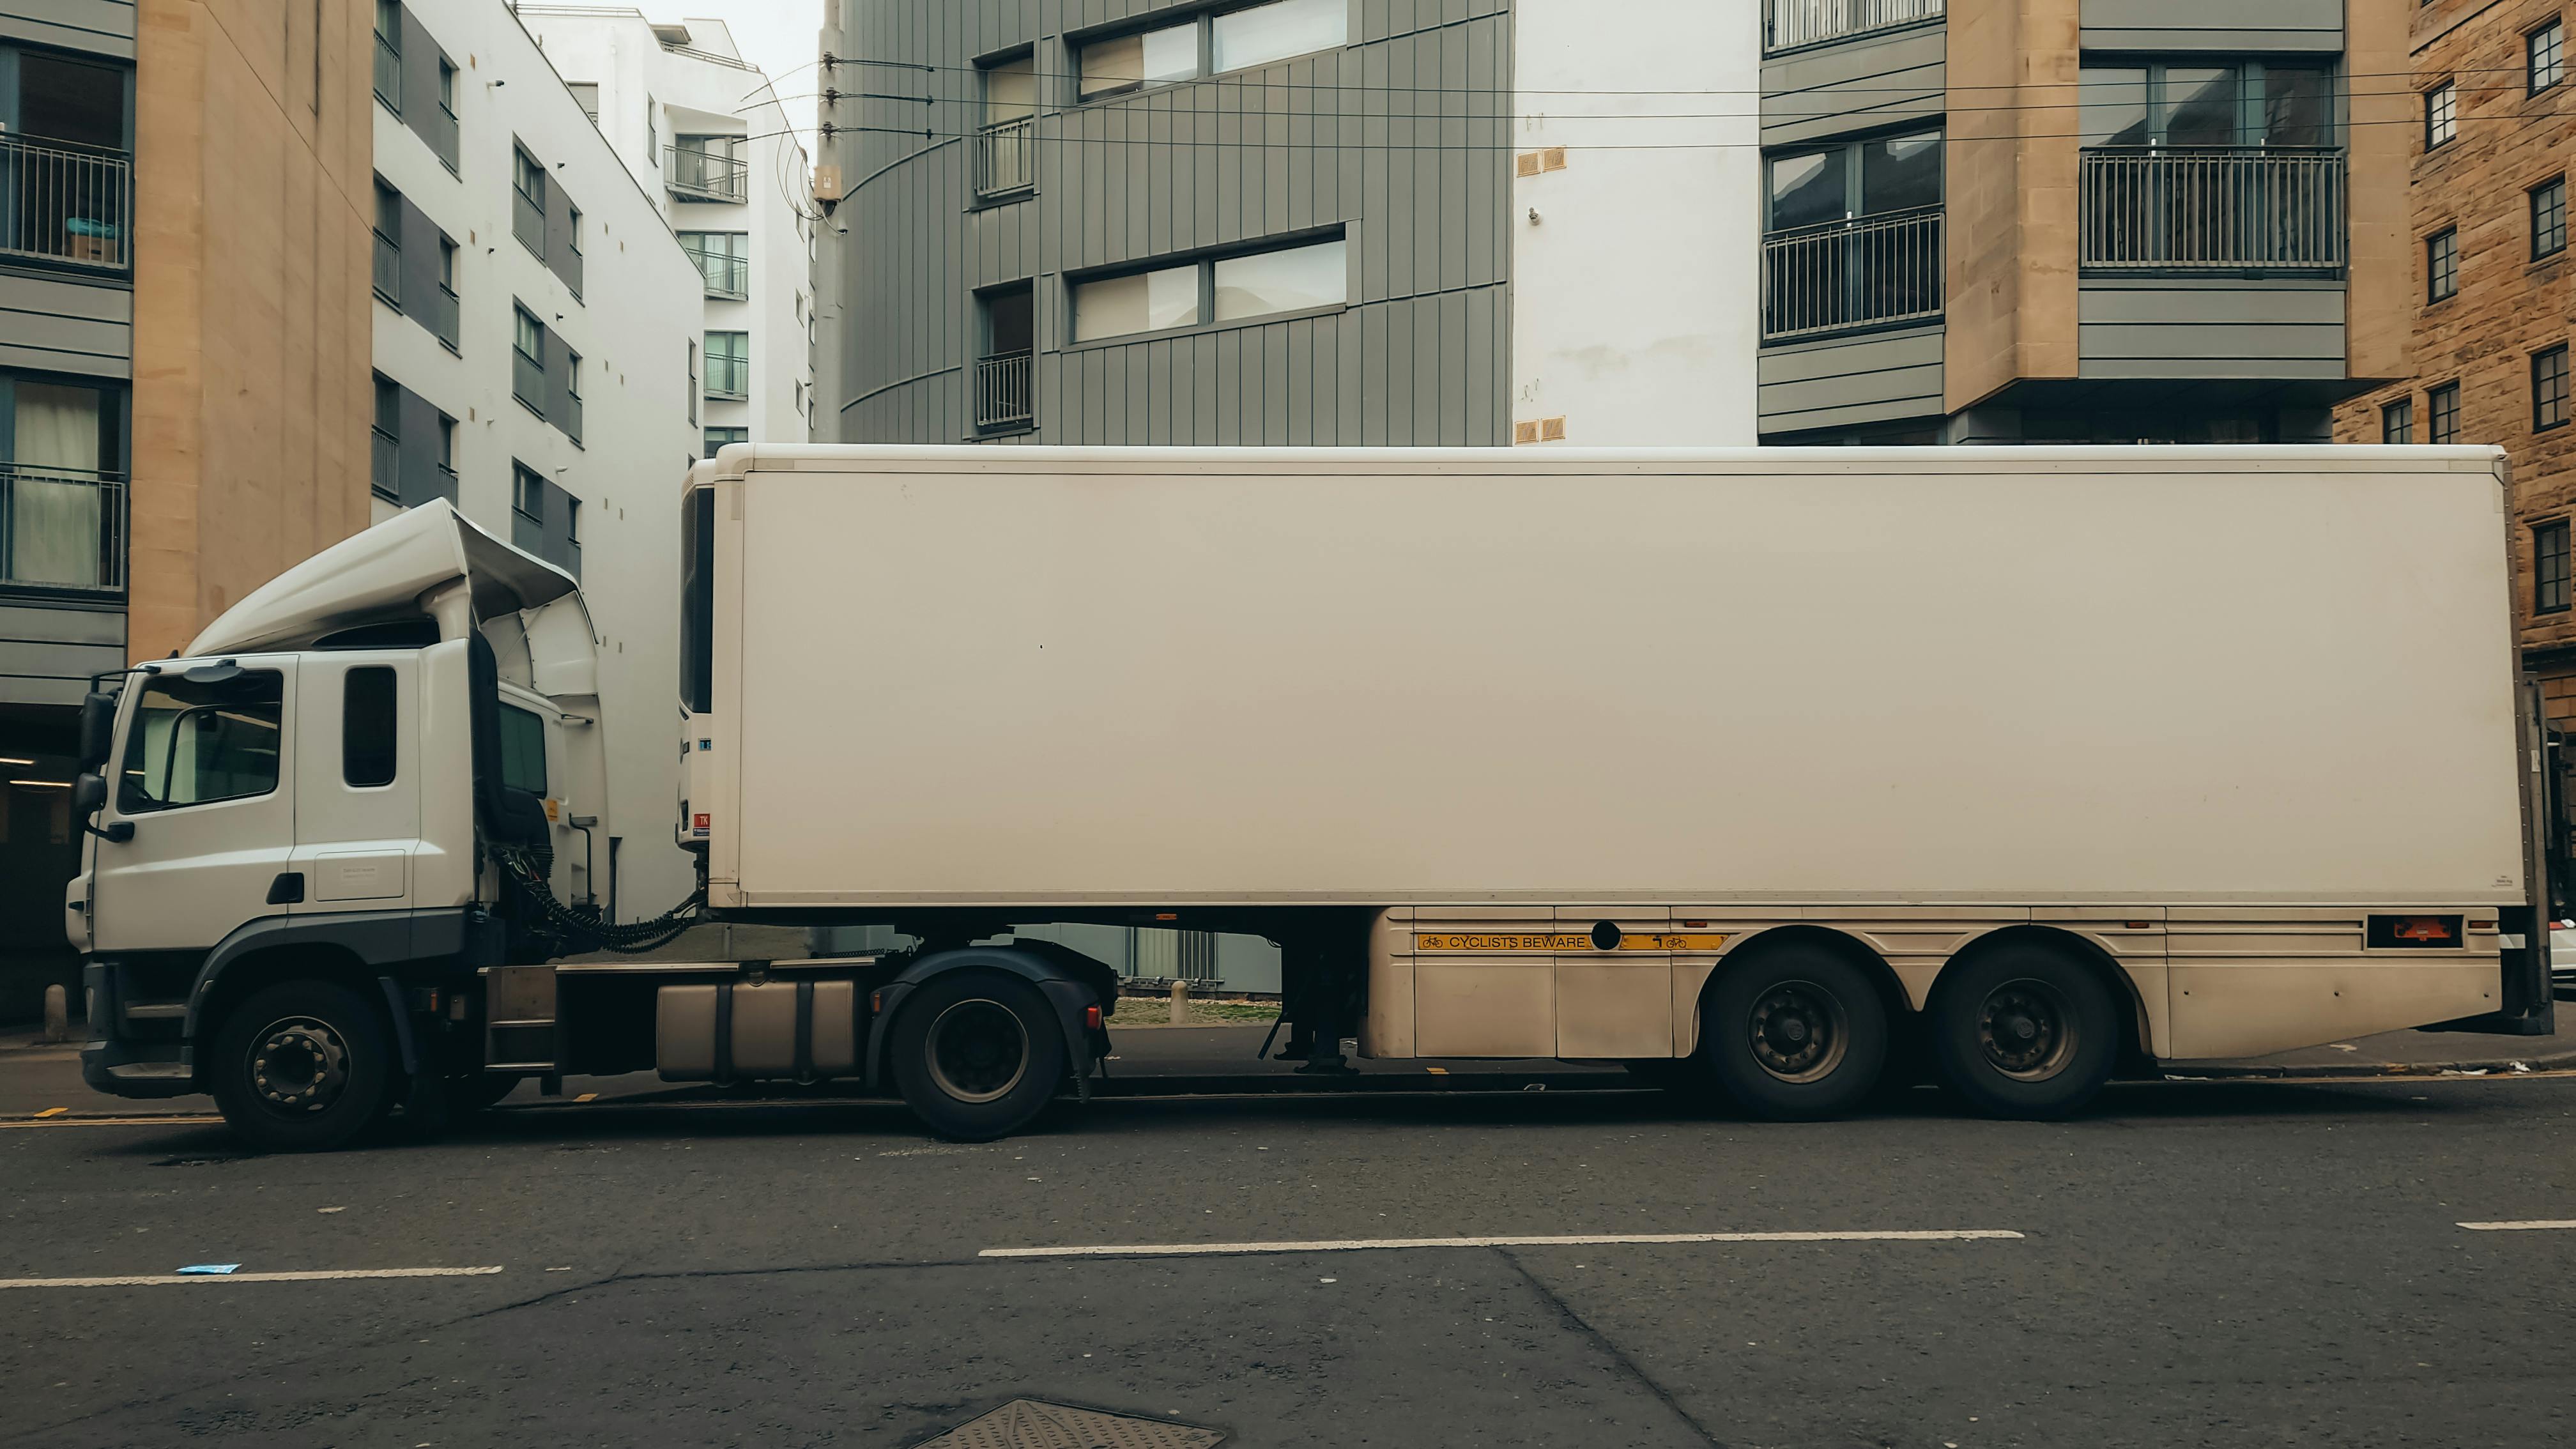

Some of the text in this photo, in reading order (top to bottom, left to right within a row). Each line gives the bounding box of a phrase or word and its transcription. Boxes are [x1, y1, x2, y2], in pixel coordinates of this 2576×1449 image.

[700, 816, 708, 825] TK
[1450, 937, 1585, 948] CYCLISTS BEWARE
